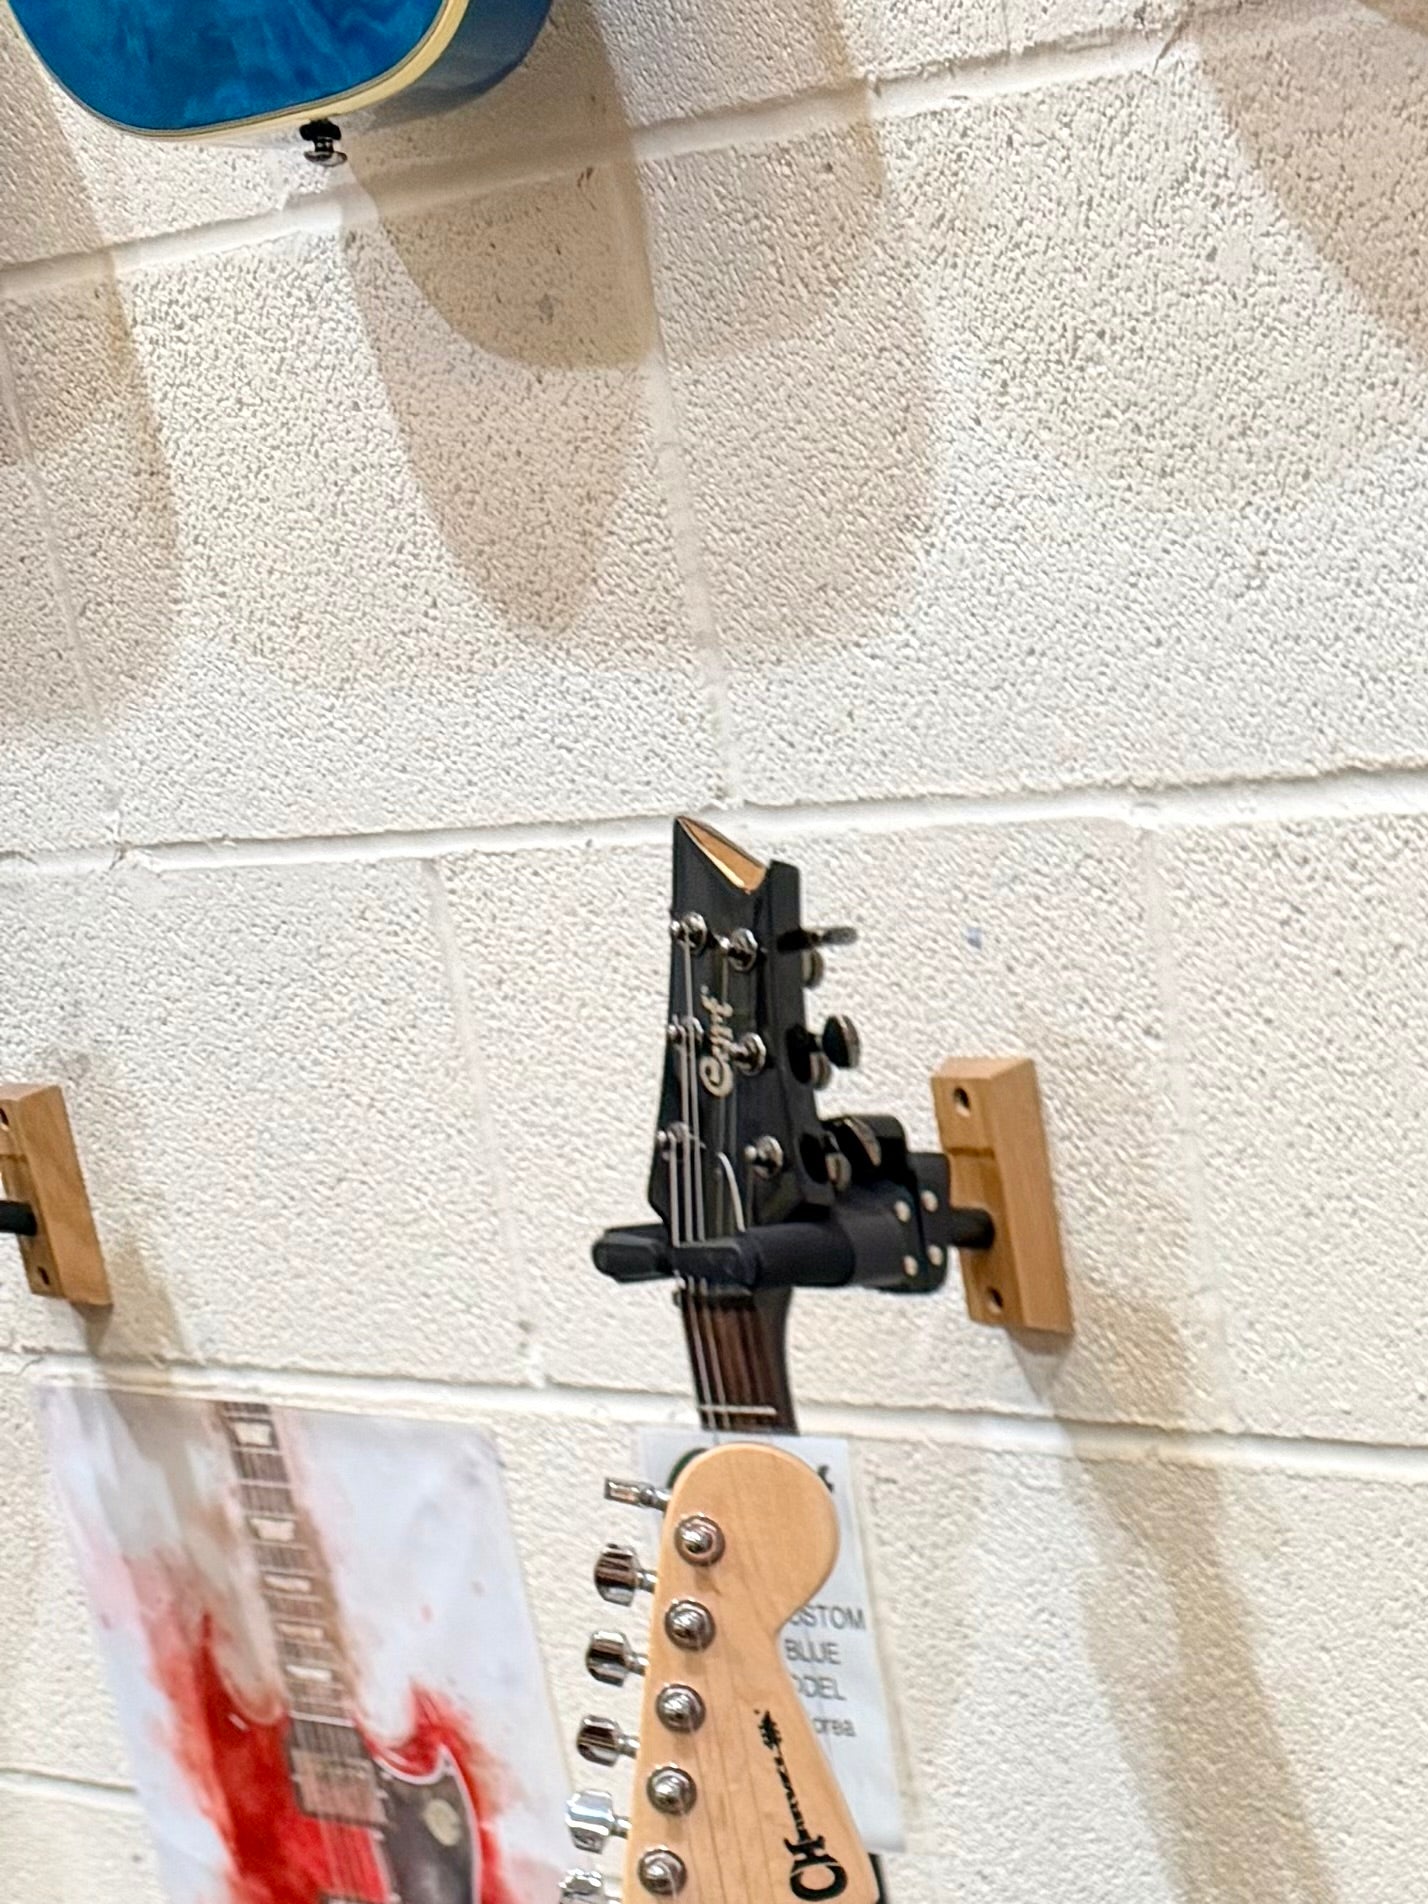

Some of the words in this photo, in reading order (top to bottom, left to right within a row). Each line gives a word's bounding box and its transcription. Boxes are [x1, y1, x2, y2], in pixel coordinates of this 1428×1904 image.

[790, 1604, 866, 1630] STOM
[785, 1638, 841, 1664] BLUE
[812, 1717, 856, 1737] orea
